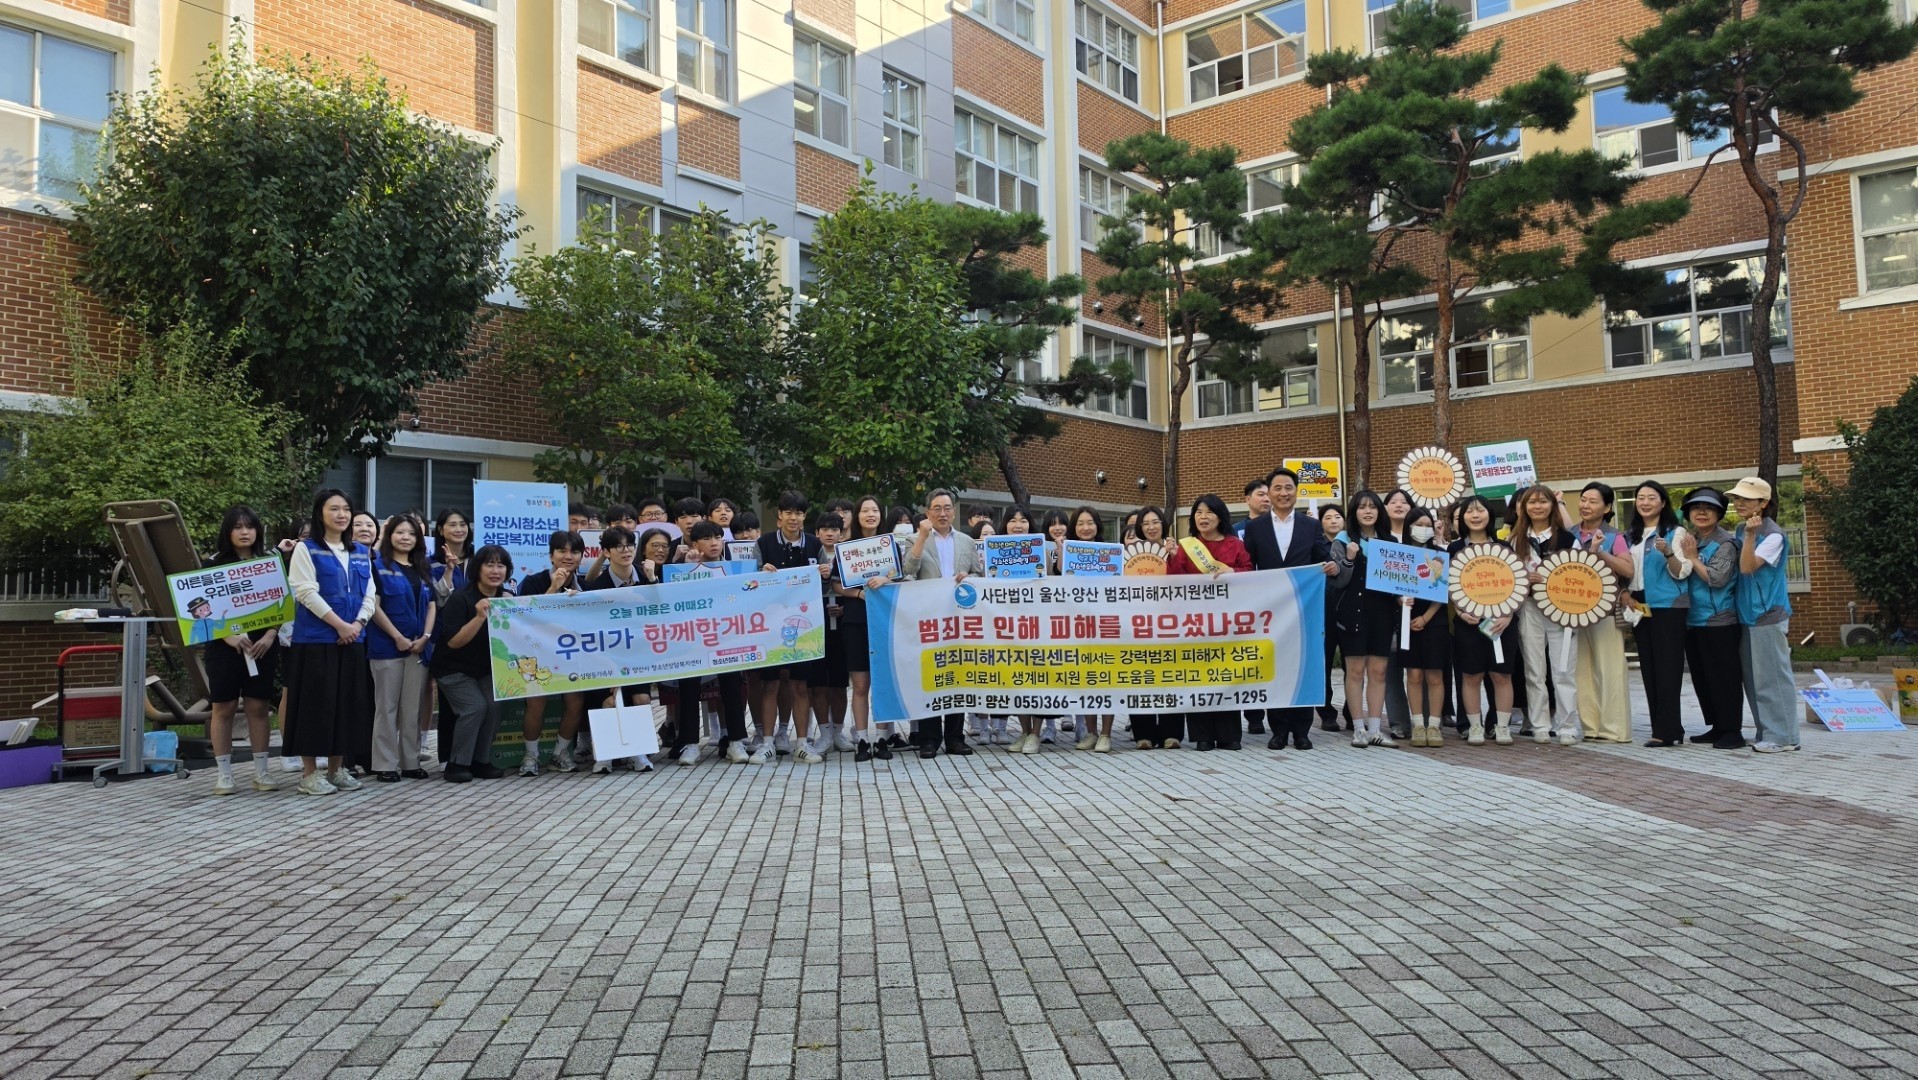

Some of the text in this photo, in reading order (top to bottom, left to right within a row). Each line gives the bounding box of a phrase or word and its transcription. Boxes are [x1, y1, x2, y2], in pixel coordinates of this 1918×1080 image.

[483, 515, 560, 531] 양산시청소년
[1379, 547, 1415, 564] 학교폭력
[177, 560, 278, 591] 어른들은 안전운전
[1374, 568, 1418, 585] 사이버폭력
[1384, 560, 1410, 573] 성폭력
[205, 579, 254, 600] 우리들은
[231, 586, 284, 608] 안전보행!
[981, 583, 1230, 604] 사단법인 울산·양산 범죄피해자지원센터
[609, 598, 714, 620] 오늘 마음은 어때요?
[555, 611, 770, 660] 우리가 함께할게요
[918, 610, 1273, 644] 범죄로 인해 피해를 입으셨나요?
[740, 651, 762, 662] 1388
[934, 645, 1264, 669] 범죄피해자지원센터에서는 강력범죄 피해자 상담,
[934, 666, 1264, 688] 법률, 의료비, 생계비 지원 등의 도움을 드리고 있습니다.
[985, 694, 1011, 709] 양산
[1014, 694, 1112, 710] 055)366-1295
[1189, 689, 1268, 708] 1577-1295
